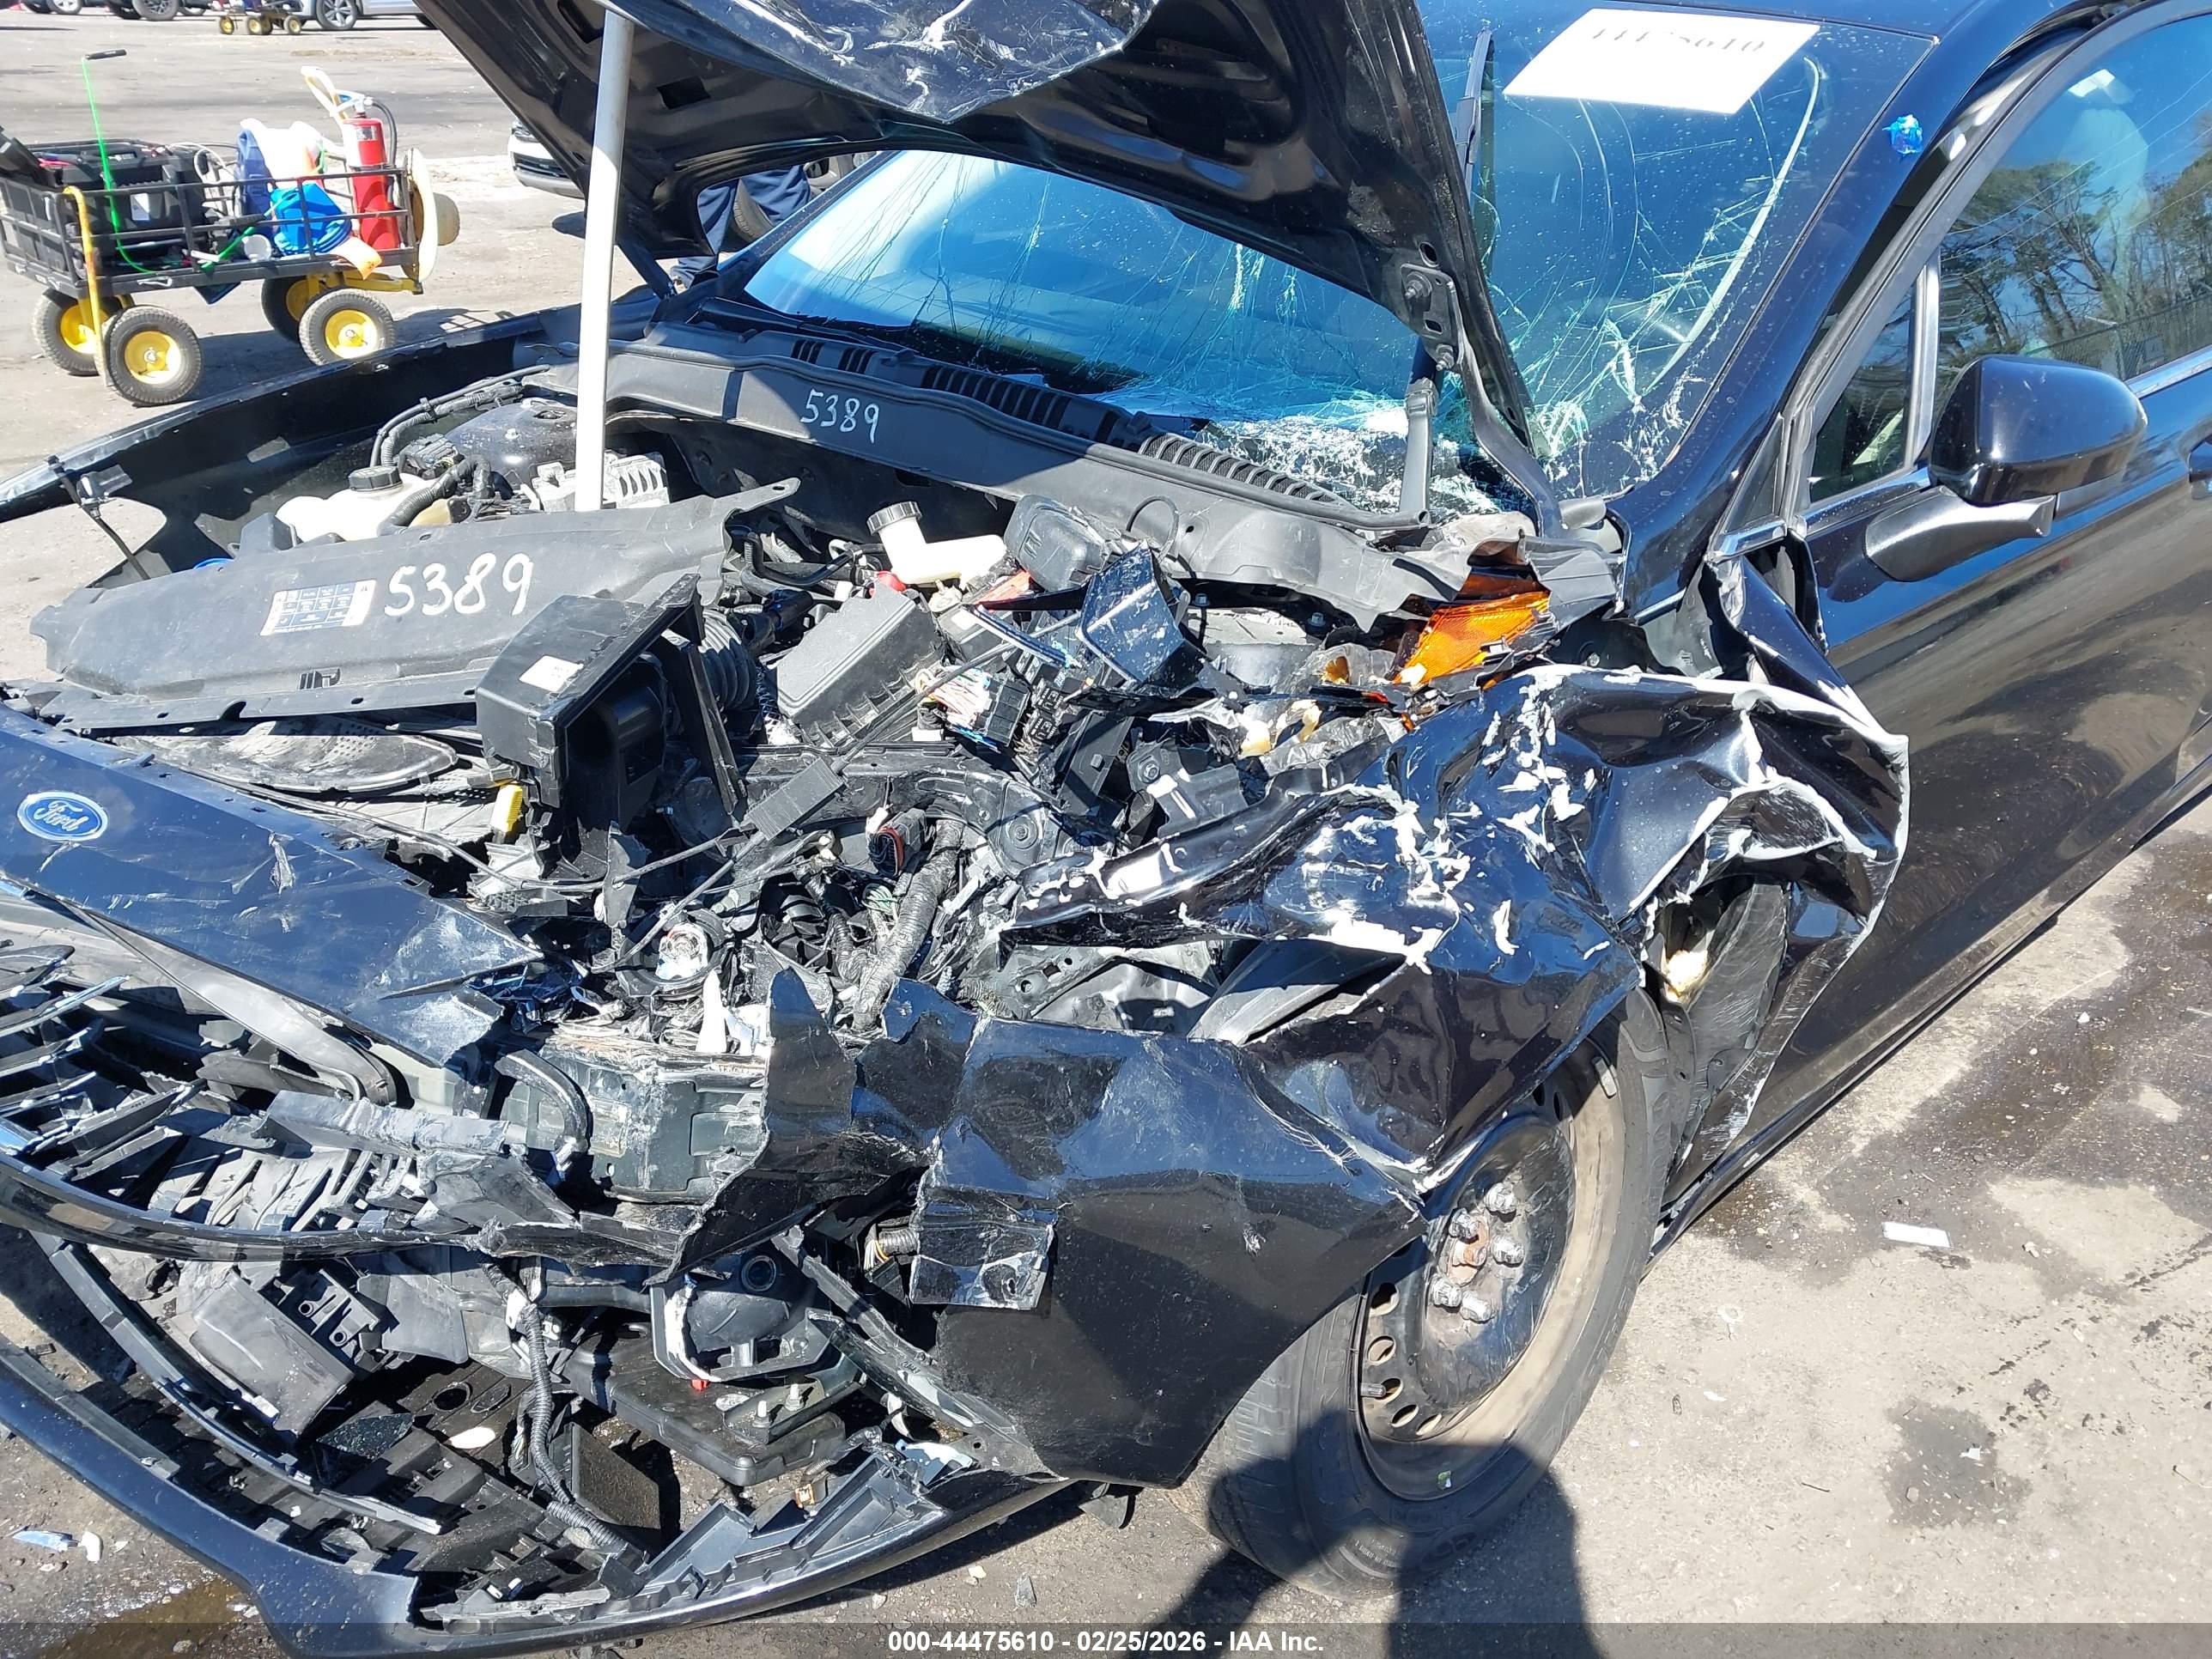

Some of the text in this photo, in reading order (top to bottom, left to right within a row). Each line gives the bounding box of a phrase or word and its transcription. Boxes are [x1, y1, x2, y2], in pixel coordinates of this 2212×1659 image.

[799, 388, 880, 444] 5389
[384, 552, 534, 617] 5389
[33, 799, 89, 832] Ford
